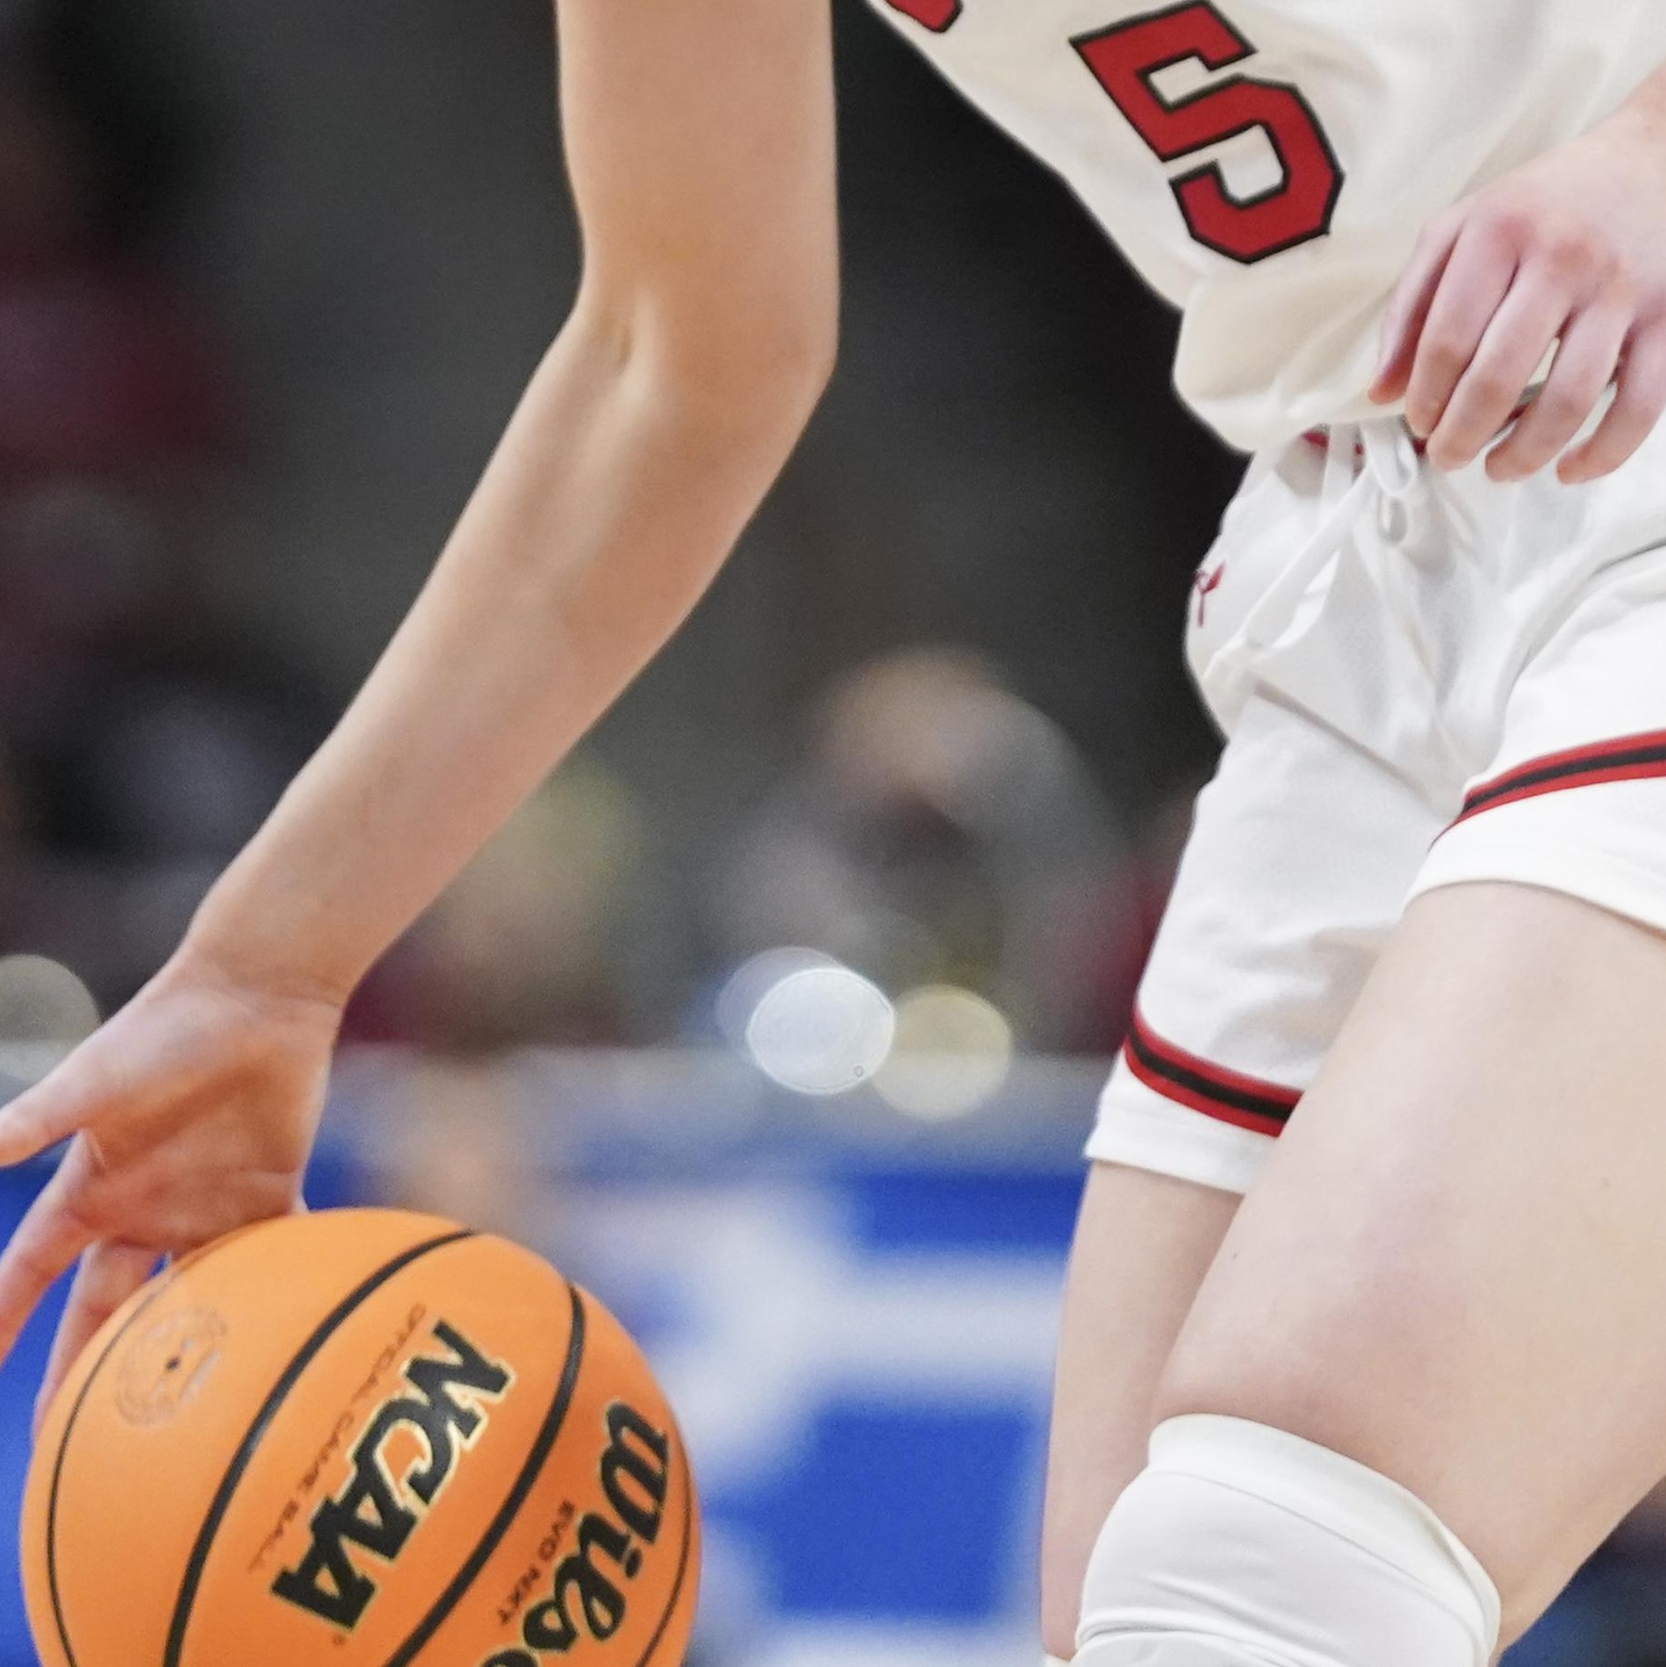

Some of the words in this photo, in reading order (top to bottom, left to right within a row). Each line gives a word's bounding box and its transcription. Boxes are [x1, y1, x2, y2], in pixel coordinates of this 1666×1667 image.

[270, 1318, 517, 1632] NCAA
[298, 1408, 355, 1494] GAME
[247, 1498, 299, 1575] BALL
[537, 1499, 575, 1562] EVO
[498, 1566, 541, 1626] NXT
